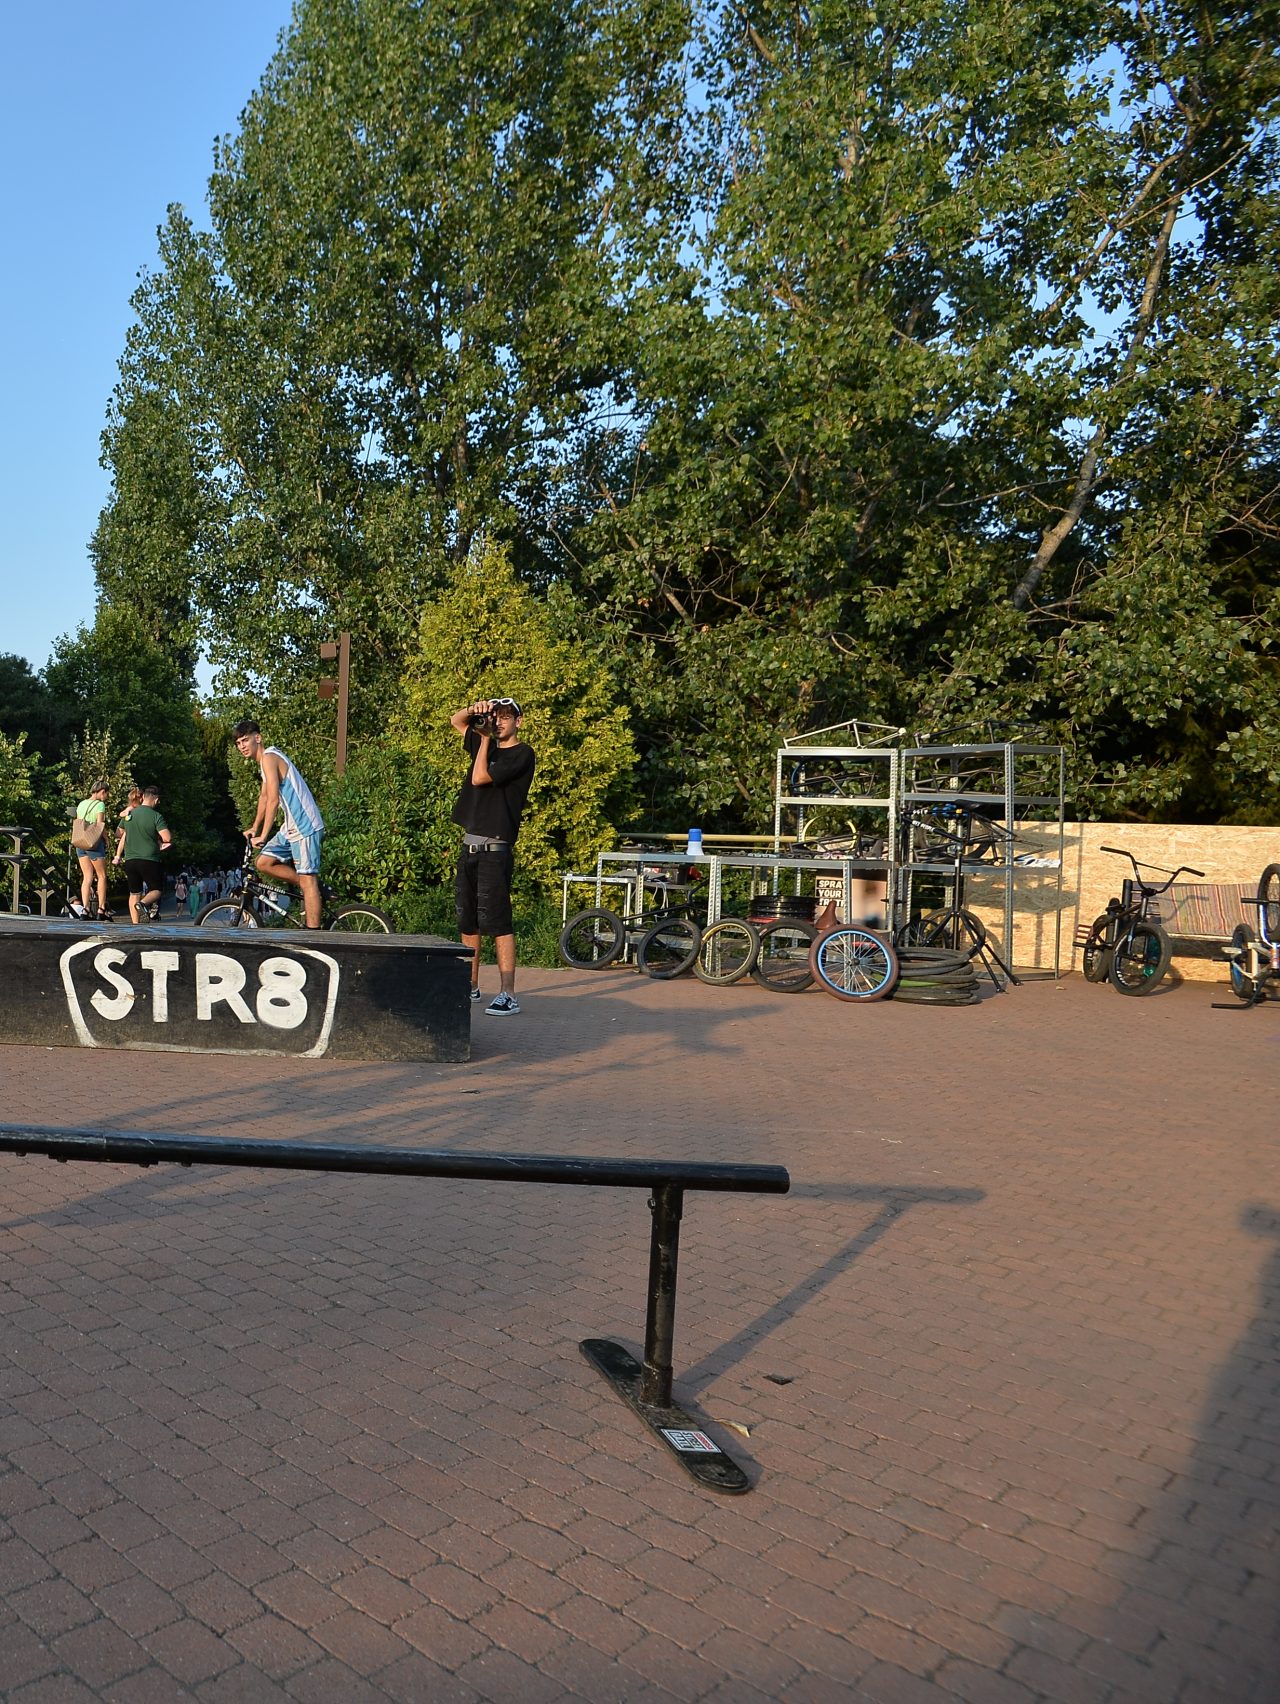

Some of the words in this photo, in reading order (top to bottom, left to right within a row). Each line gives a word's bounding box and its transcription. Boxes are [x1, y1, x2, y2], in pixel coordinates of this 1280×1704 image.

[818, 889, 842, 898] YOUR
[818, 898, 845, 907] TRT
[89, 947, 308, 1030] STR8
